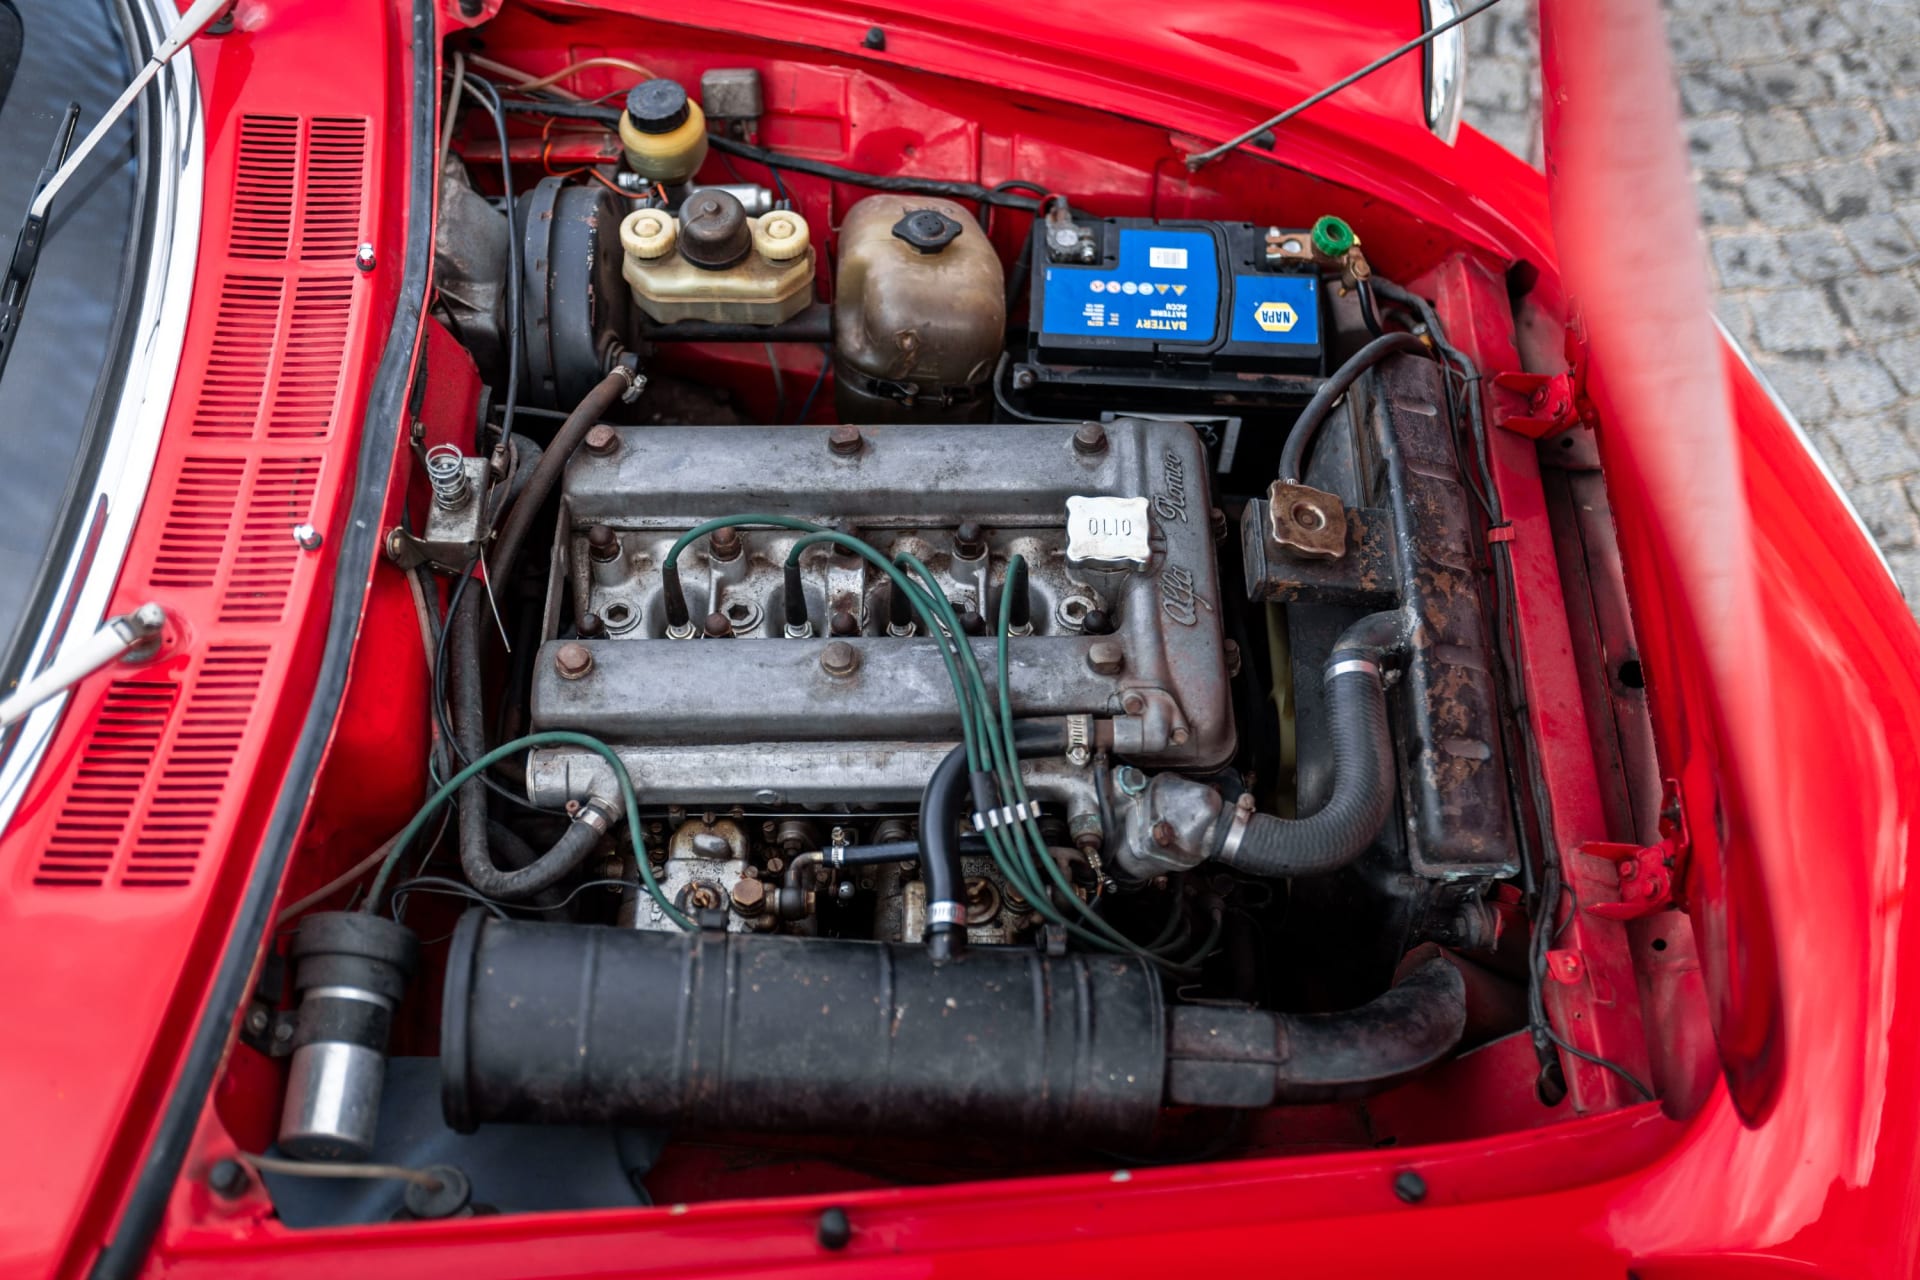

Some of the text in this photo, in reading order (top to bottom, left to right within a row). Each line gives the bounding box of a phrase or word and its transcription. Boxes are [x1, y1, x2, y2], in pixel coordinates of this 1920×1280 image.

[1135, 318, 1187, 331] BATTERY
[1261, 310, 1291, 325] NAPA
[1153, 451, 1188, 524] Romeo
[1088, 517, 1132, 536] OLIO
